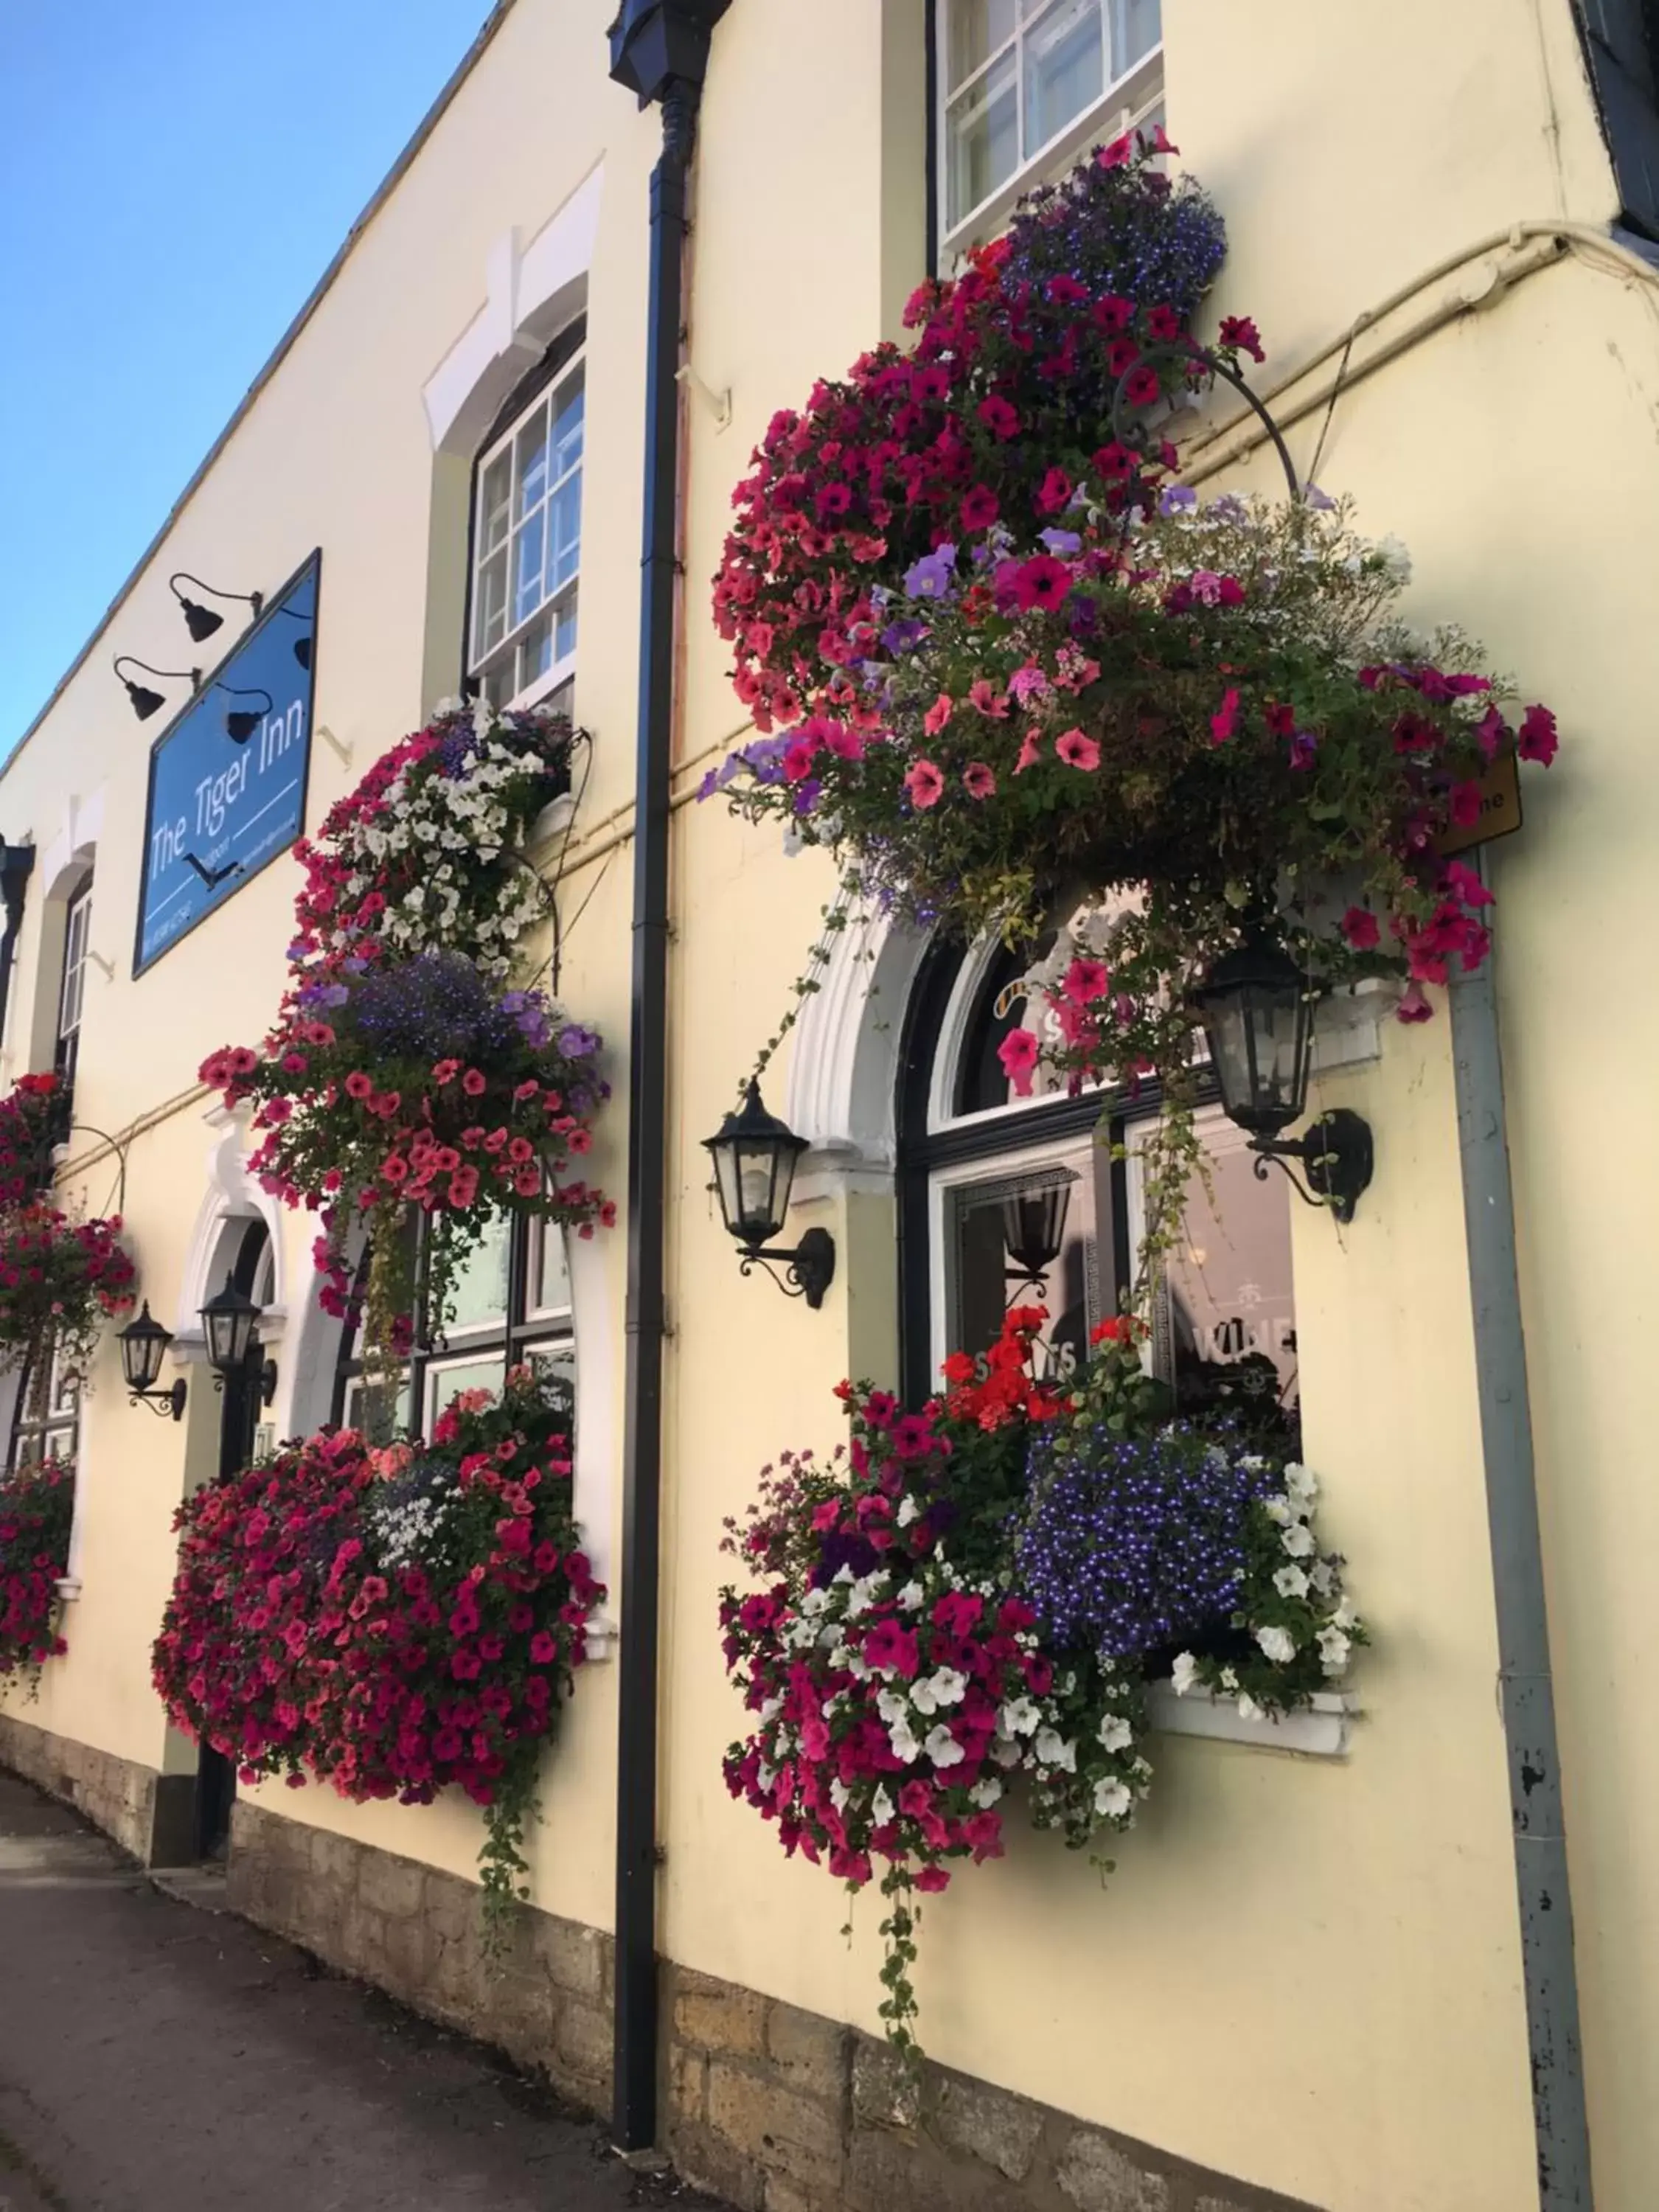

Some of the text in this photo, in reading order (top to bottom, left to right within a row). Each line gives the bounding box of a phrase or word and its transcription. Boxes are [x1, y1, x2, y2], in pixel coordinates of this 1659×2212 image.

[152, 815, 187, 881] The
[195, 747, 251, 838] Tiger
[259, 698, 303, 775] Inn
